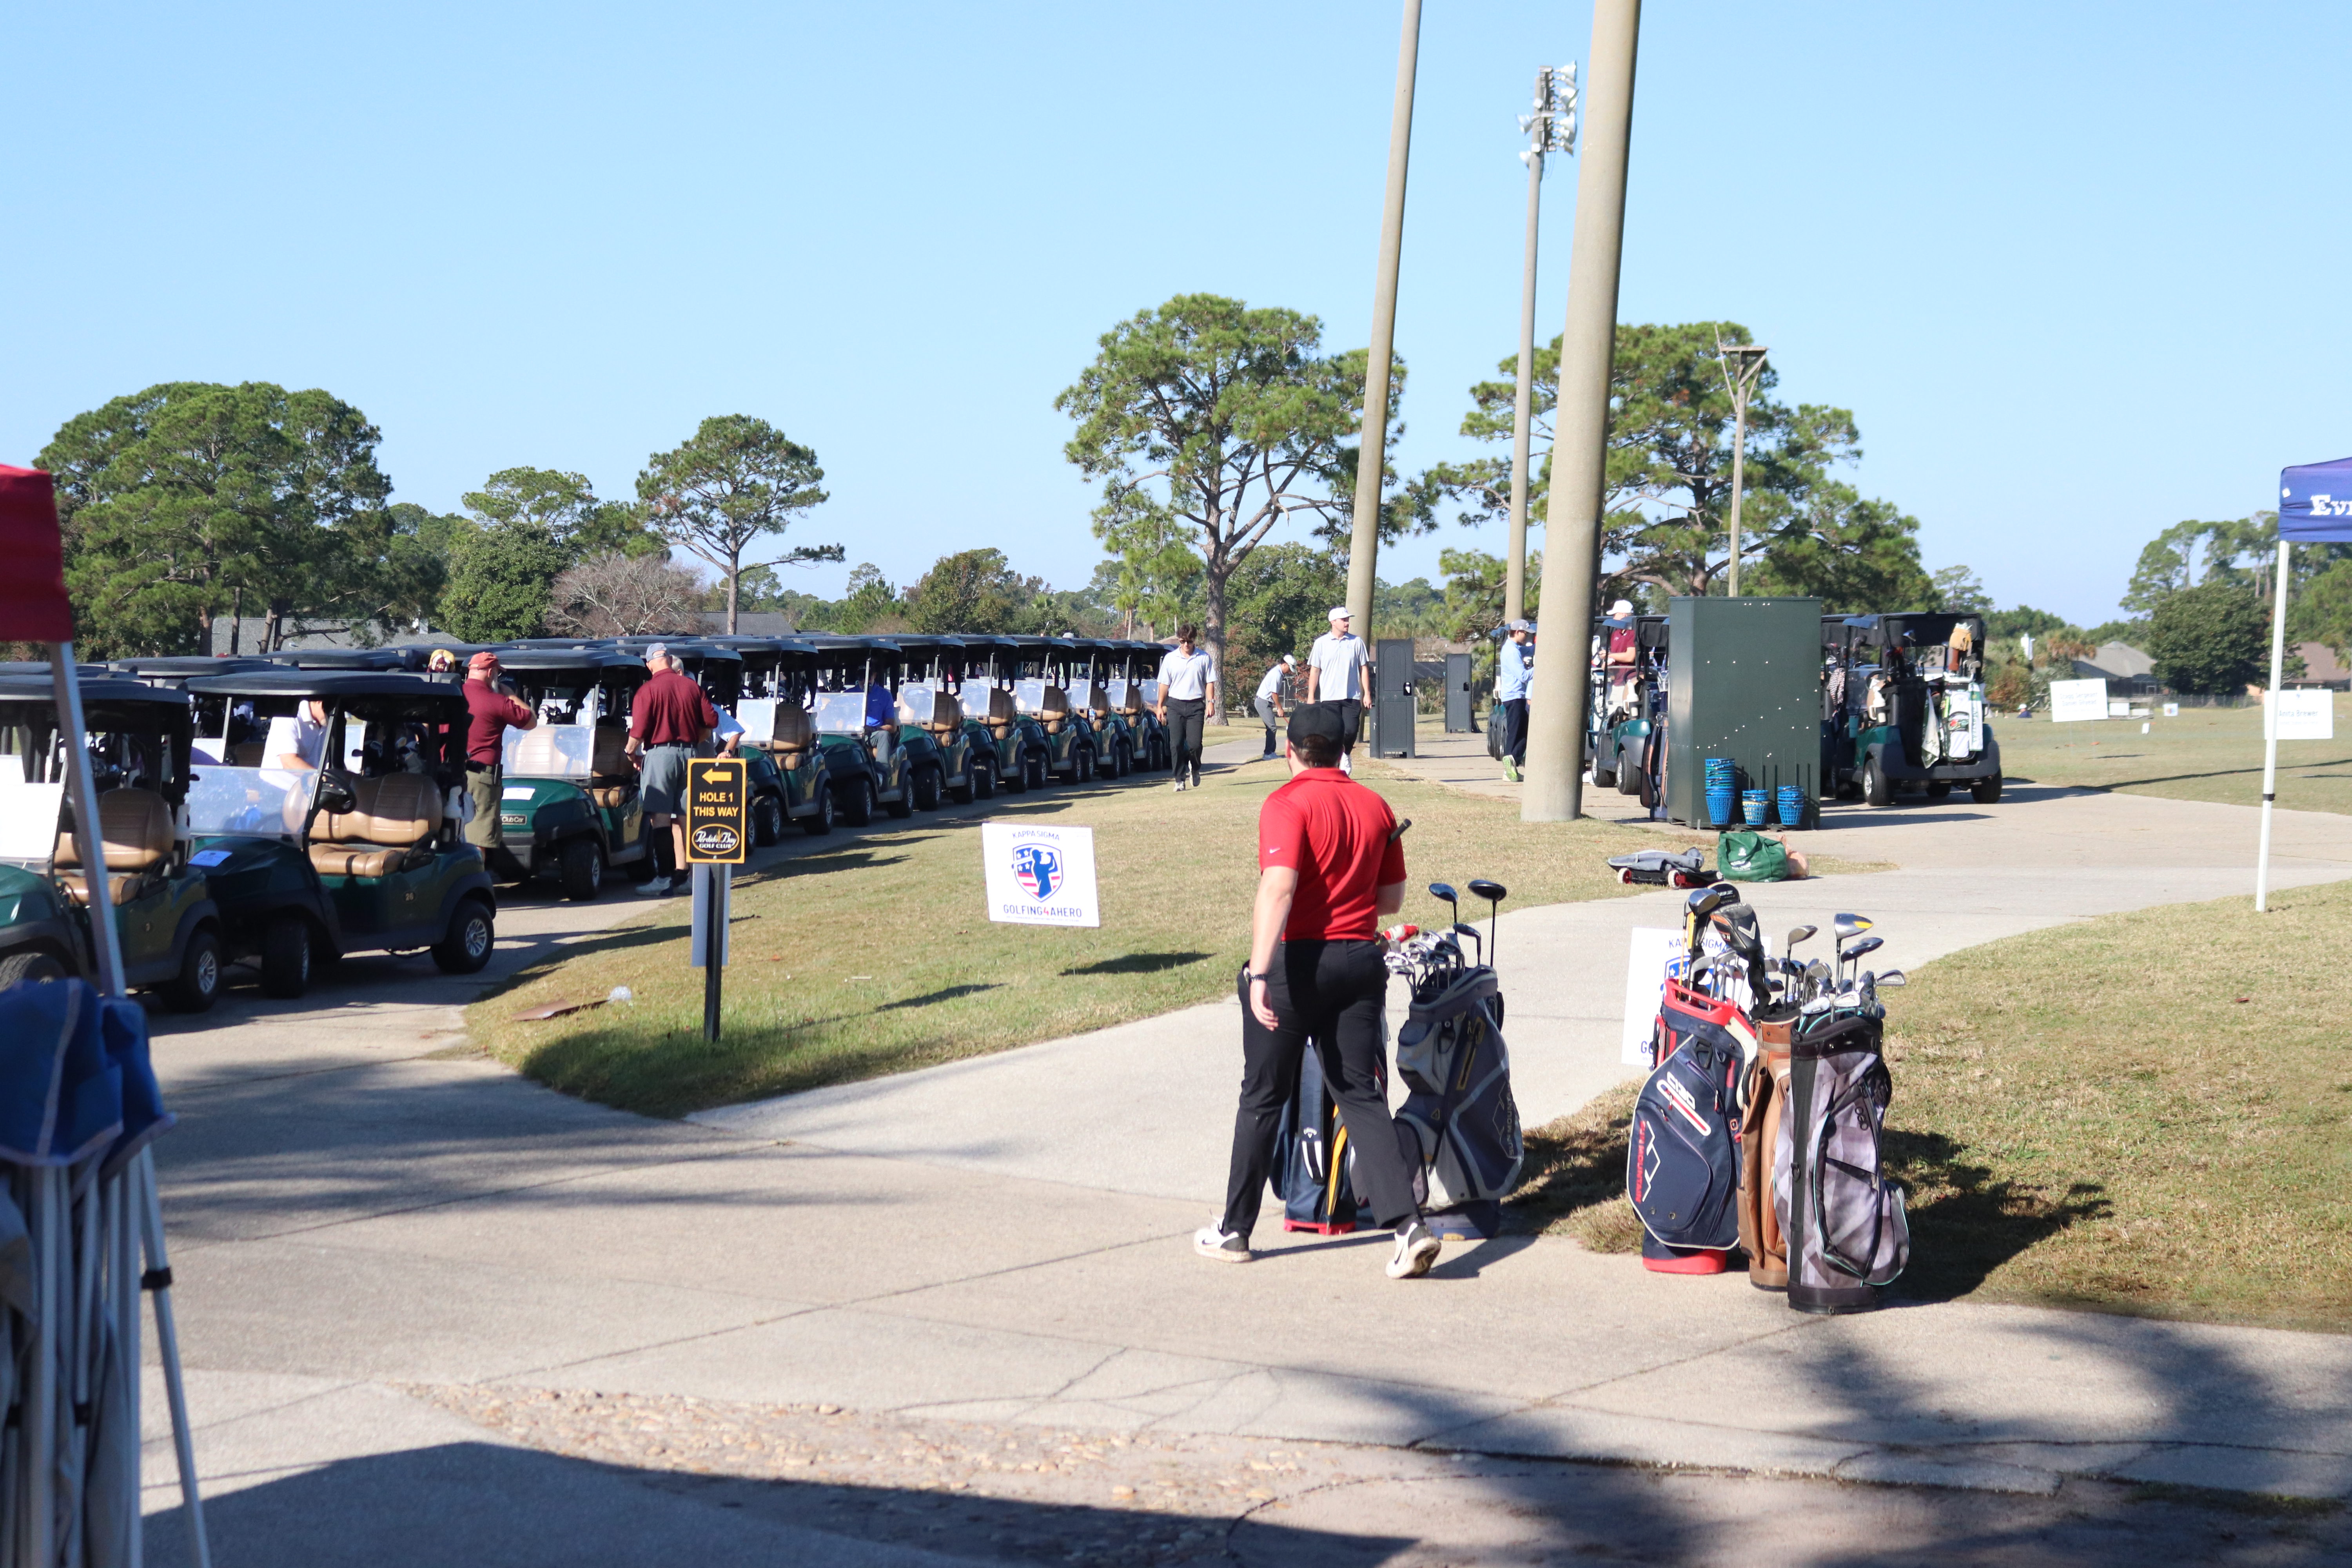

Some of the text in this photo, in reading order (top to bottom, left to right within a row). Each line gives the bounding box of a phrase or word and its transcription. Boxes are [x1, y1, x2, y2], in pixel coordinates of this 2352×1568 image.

[699, 792, 733, 802] HOLE 1
[693, 806, 739, 817] THIS WAY
[695, 831, 737, 846] Perdido Bay
[1012, 830, 1060, 840] KAPPA SIGMA
